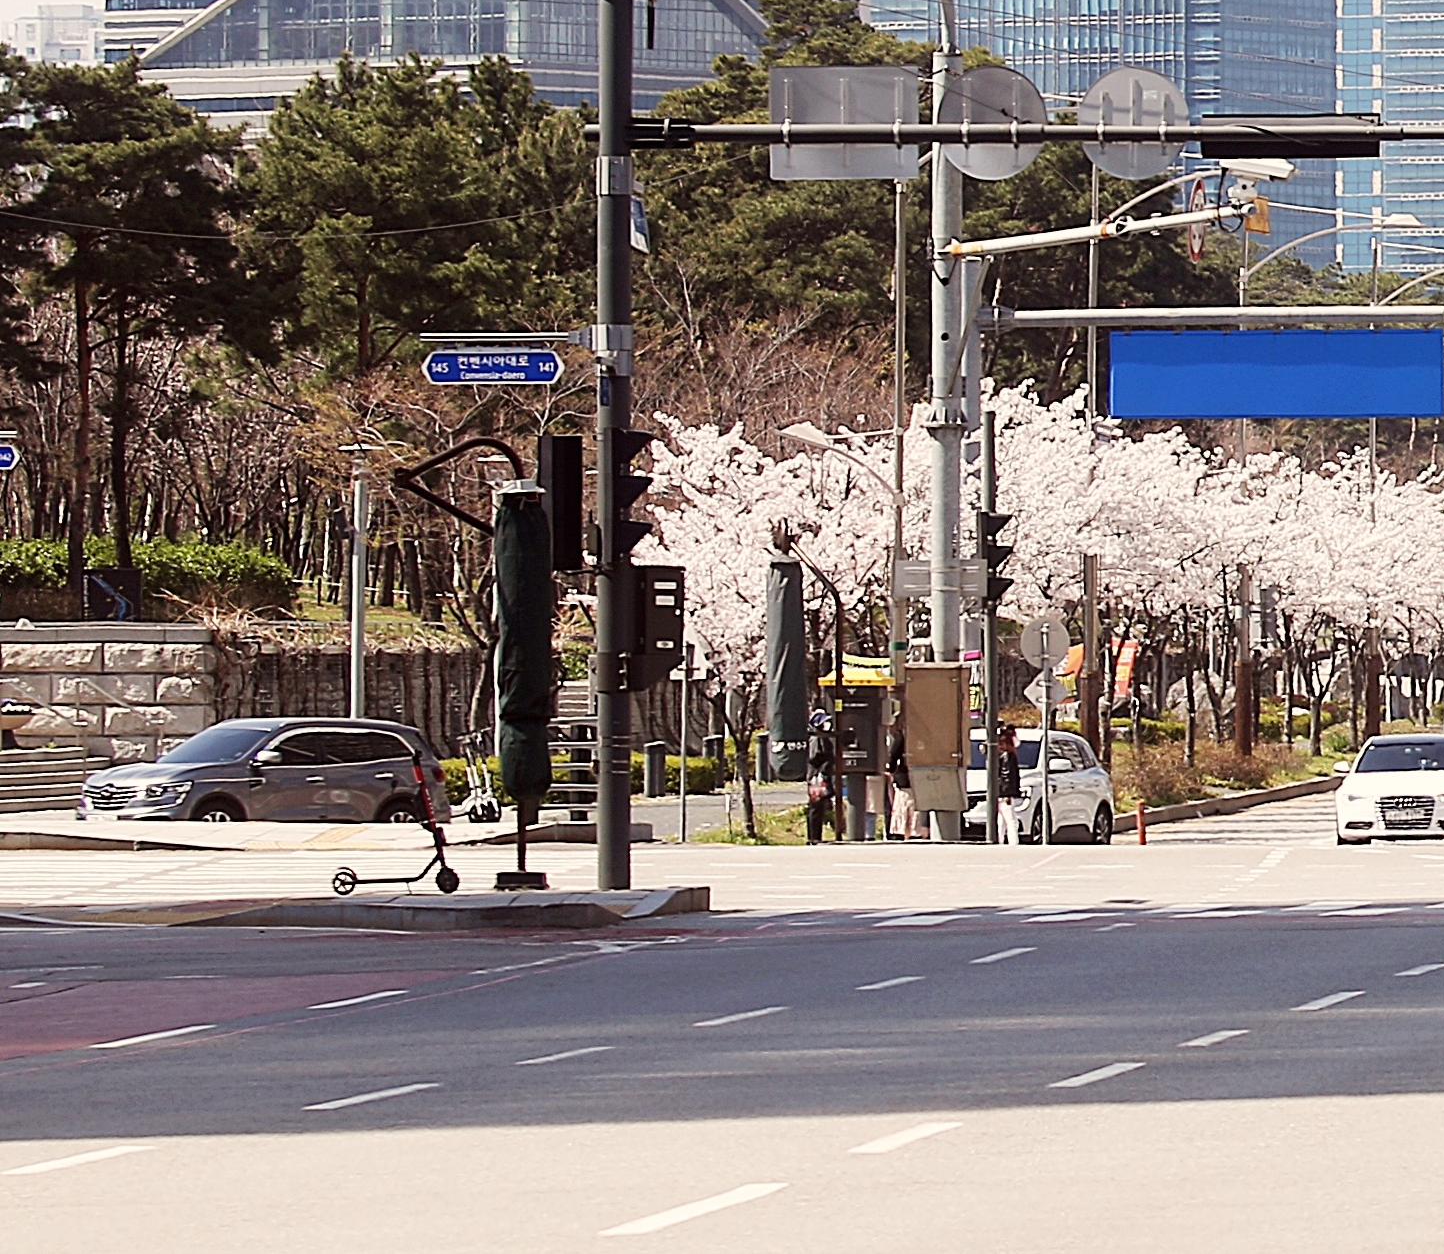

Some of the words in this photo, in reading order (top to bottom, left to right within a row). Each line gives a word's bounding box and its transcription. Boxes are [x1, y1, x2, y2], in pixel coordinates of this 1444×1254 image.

[431, 363, 449, 373] 145
[457, 355, 529, 369] 컨벤시아대로
[538, 362, 555, 372] 141
